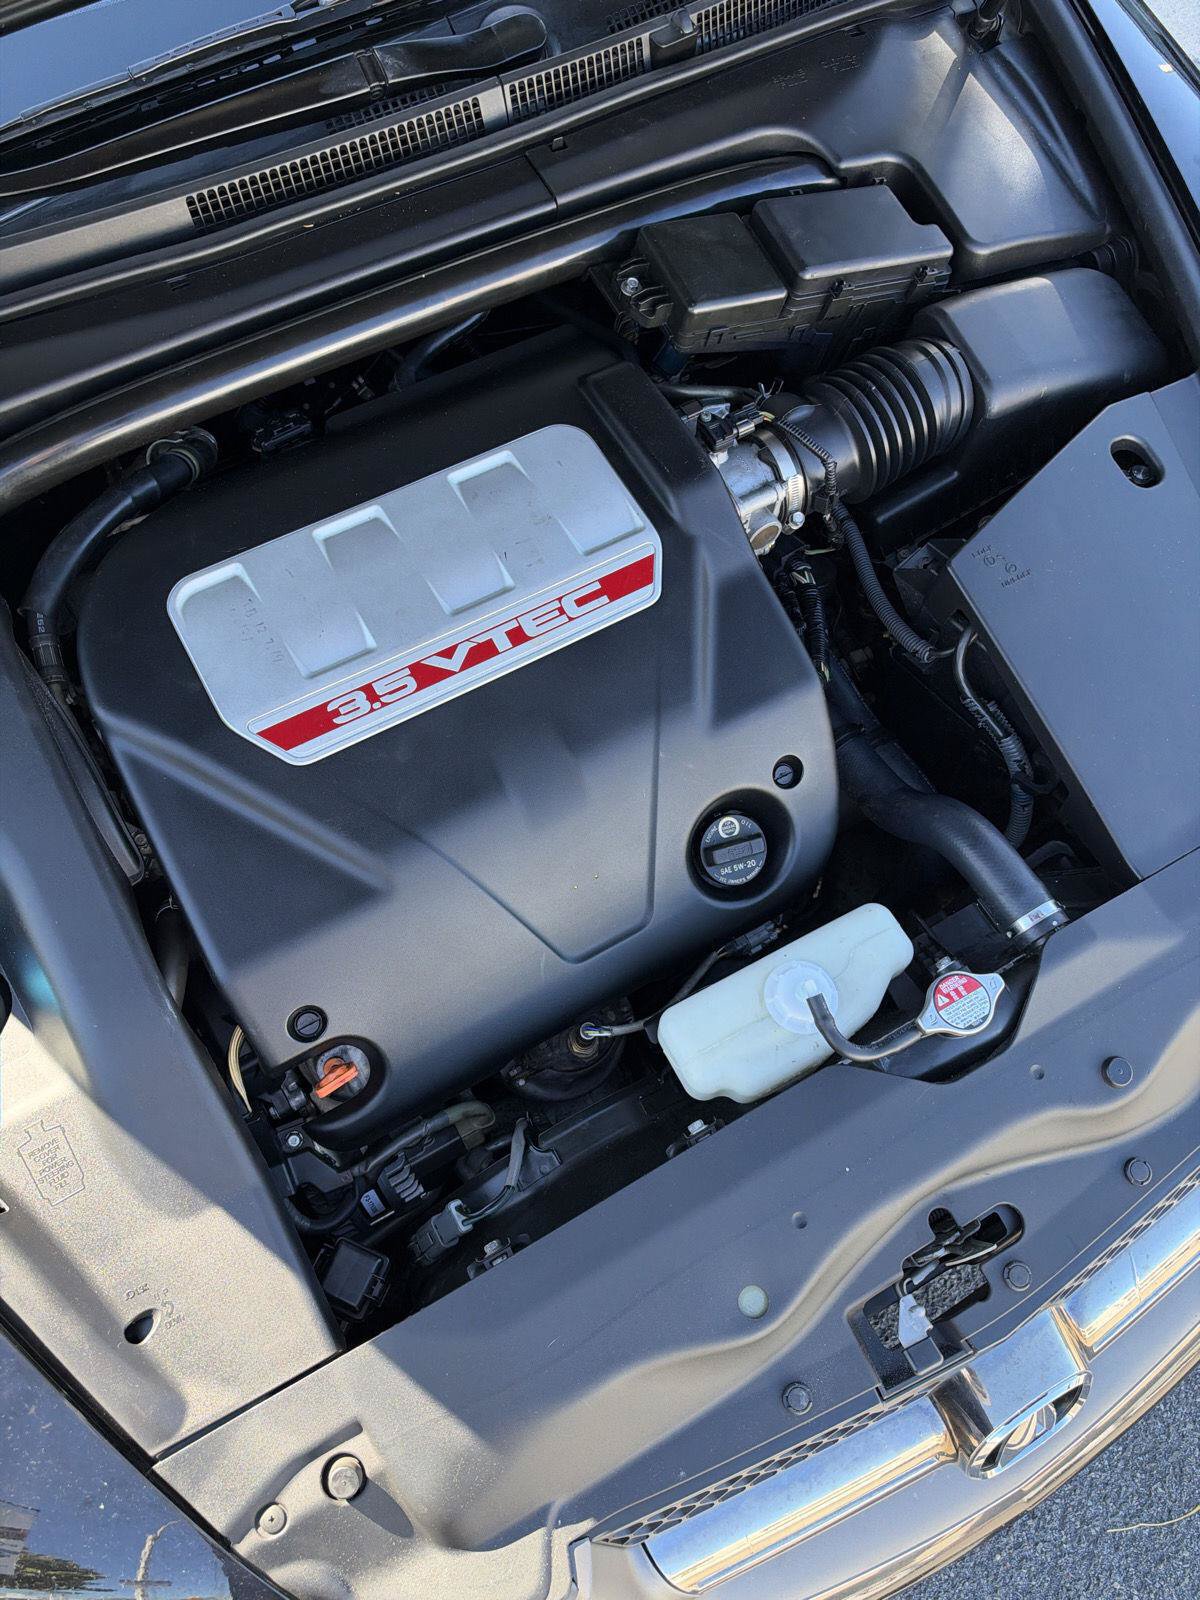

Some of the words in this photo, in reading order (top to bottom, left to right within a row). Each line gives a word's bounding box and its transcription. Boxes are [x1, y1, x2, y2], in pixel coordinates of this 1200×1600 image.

[326, 667, 419, 726] 3.5
[419, 580, 610, 673] VTEC
[720, 866, 733, 875] SAE
[733, 859, 757, 872] 5W-20
[28, 1137, 60, 1159] REMOVE
[34, 1144, 61, 1163] COVER
[39, 1156, 67, 1176] POWER
[42, 1153, 58, 1166] FOR
[38, 1160, 75, 1184] STEERING
[49, 1171, 69, 1187] FLUID
